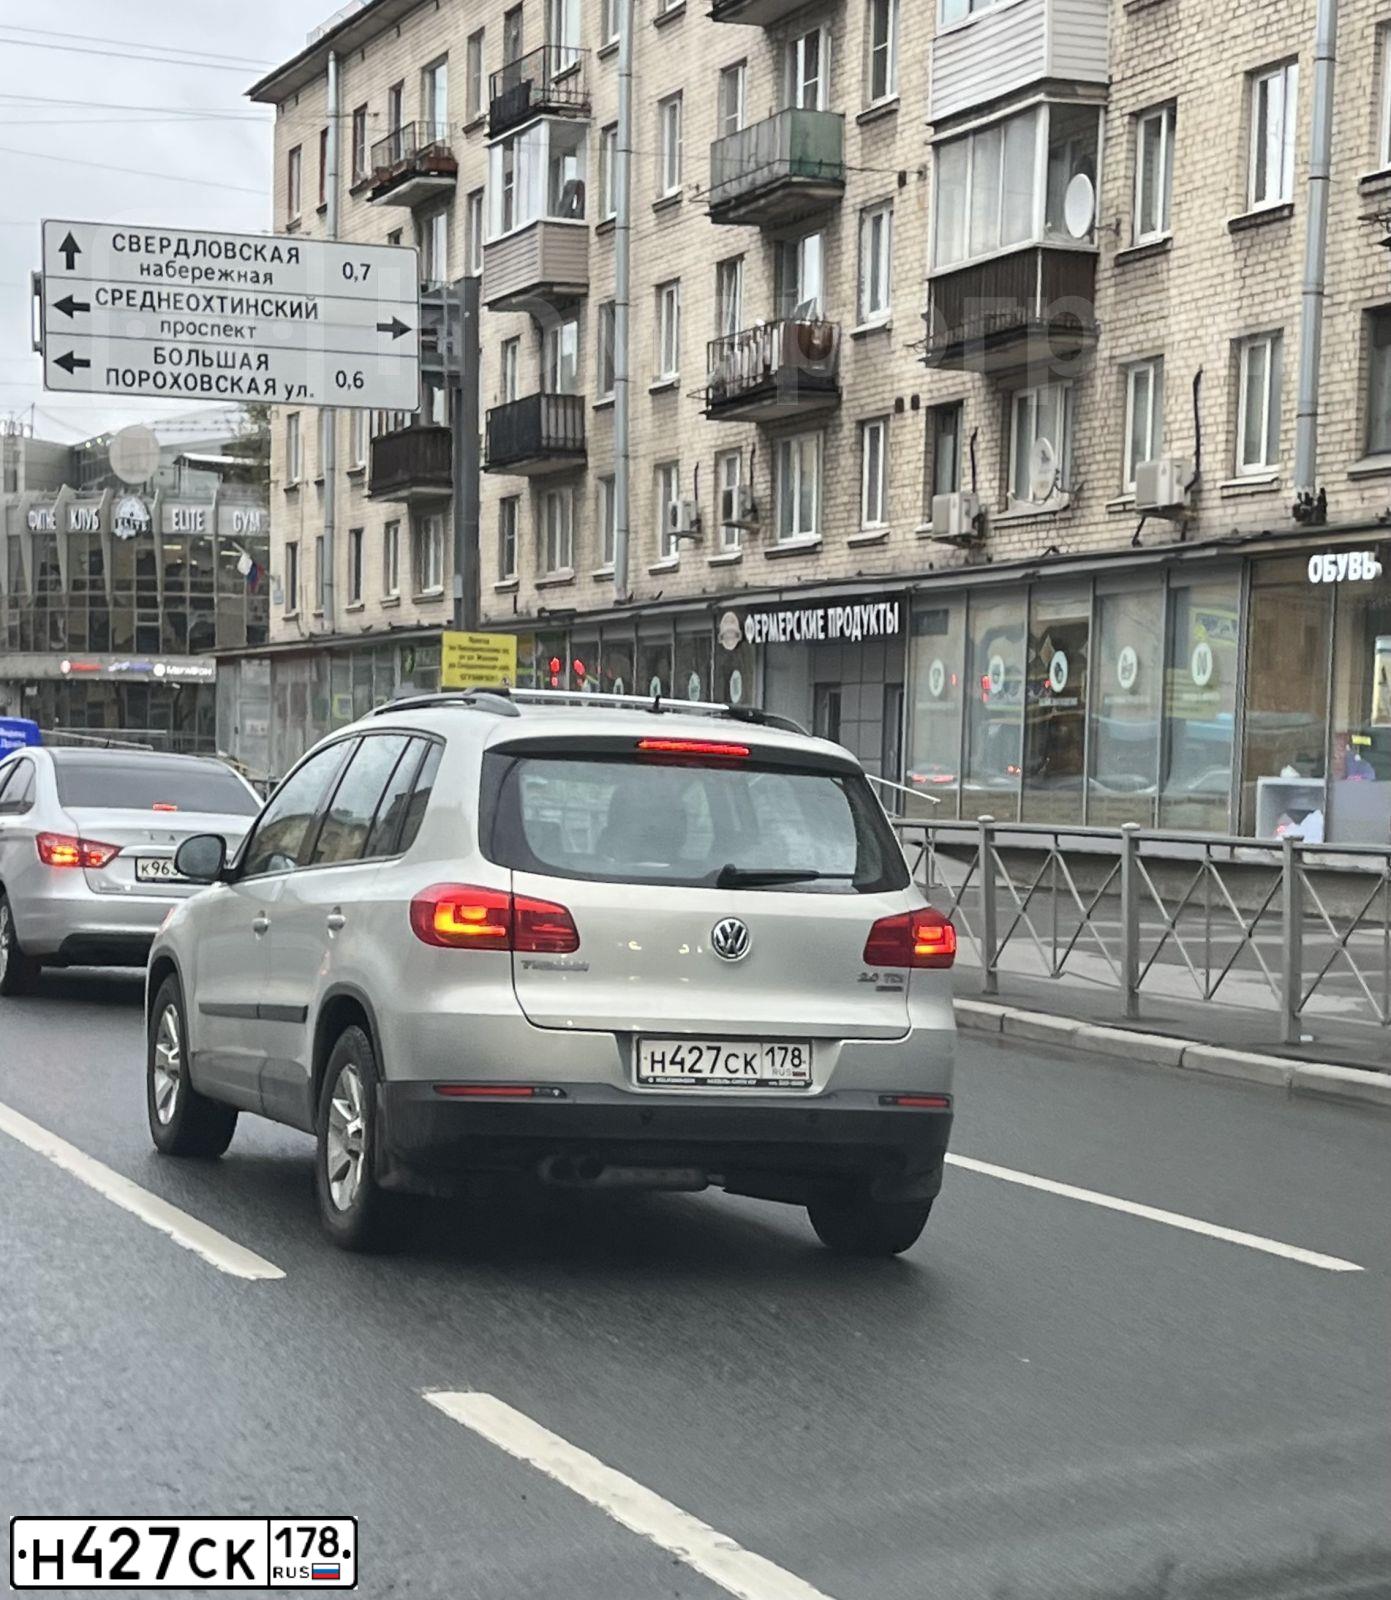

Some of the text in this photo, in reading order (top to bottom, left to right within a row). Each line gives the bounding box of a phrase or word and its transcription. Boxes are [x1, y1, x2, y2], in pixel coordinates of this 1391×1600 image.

[112, 233, 301, 264] СВЕРДЛОВСКАЯ
[139, 260, 371, 286] набережная 0,7
[95, 287, 319, 320] СРЕДНЕОХТИНСКИЙ
[160, 319, 257, 340] проспект
[153, 347, 270, 371] БОЛЬШАЯ
[106, 368, 365, 401] ПОРОХОВСКАЯ ул. 0,6
[70, 508, 99, 530] КЛУБ
[172, 508, 261, 532] ELITE GYM
[1308, 551, 1382, 583] ОБУВЬ
[744, 601, 899, 644] ФЕРМЕРСКИЕ ПРОДУКТЫ
[650, 1045, 803, 1076] Н427СК 178
[771, 1068, 793, 1077] RUS
